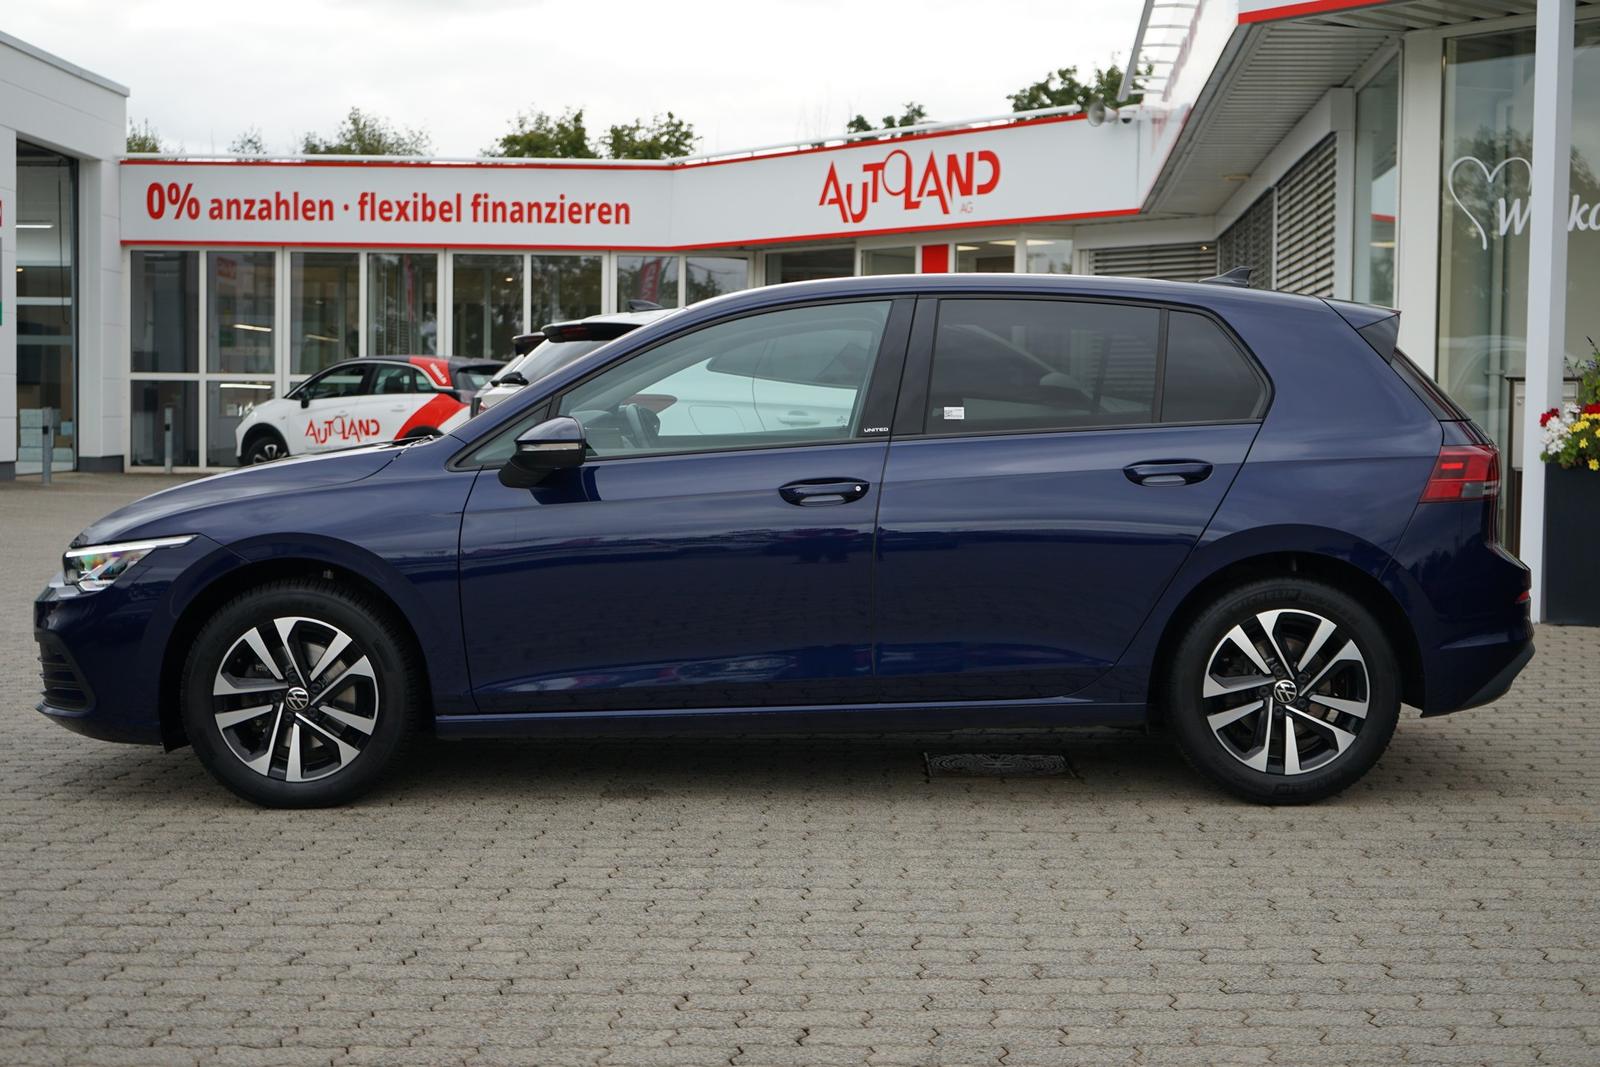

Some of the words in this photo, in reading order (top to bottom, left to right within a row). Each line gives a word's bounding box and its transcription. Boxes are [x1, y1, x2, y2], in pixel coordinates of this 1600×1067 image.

[146, 182, 201, 220] 0%
[208, 191, 334, 221] anzahlen
[358, 192, 462, 222] flexibel
[471, 193, 631, 225] finanzieren
[818, 149, 1000, 223] AUTOLAND
[959, 201, 974, 215] AG
[305, 415, 380, 444] AUTOLAND
